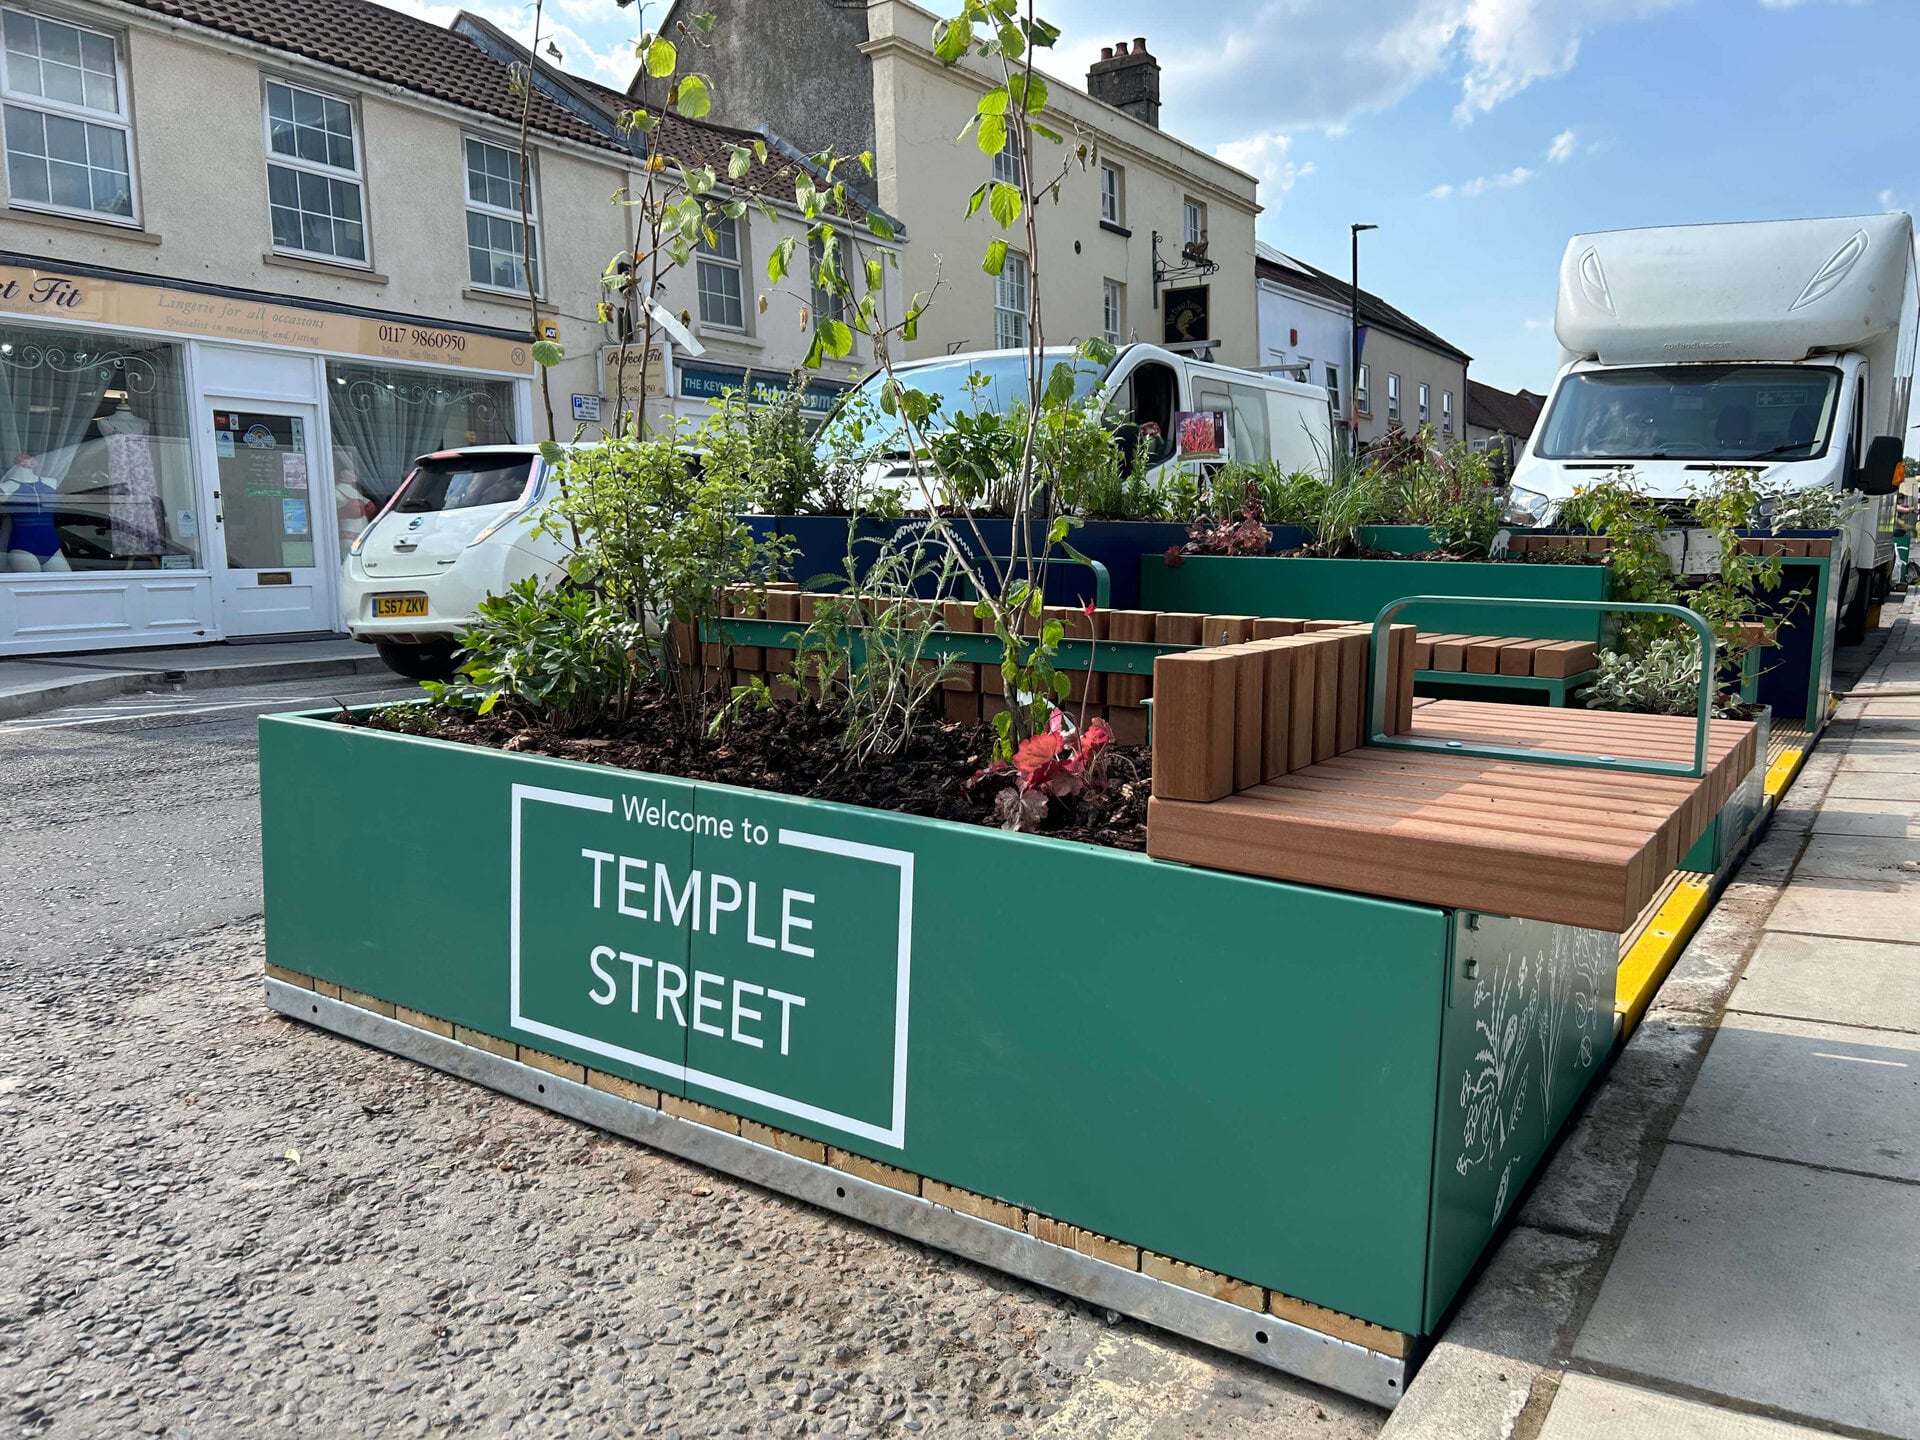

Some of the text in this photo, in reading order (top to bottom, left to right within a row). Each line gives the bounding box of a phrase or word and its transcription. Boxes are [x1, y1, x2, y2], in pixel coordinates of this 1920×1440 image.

[29, 277, 82, 307] Fit
[159, 294, 325, 329] Lingerie for all occasions
[163, 315, 320, 345] Specialist in measuring and fitting
[379, 325, 466, 351] 0117 9860950
[513, 350, 525, 363] 50
[605, 350, 643, 368] Pefect
[684, 377, 702, 390] THE
[378, 598, 425, 614] LS67 ZKV
[621, 793, 769, 845] Welcome to
[582, 847, 815, 958] TEMPLE
[588, 945, 806, 1056] STREET
